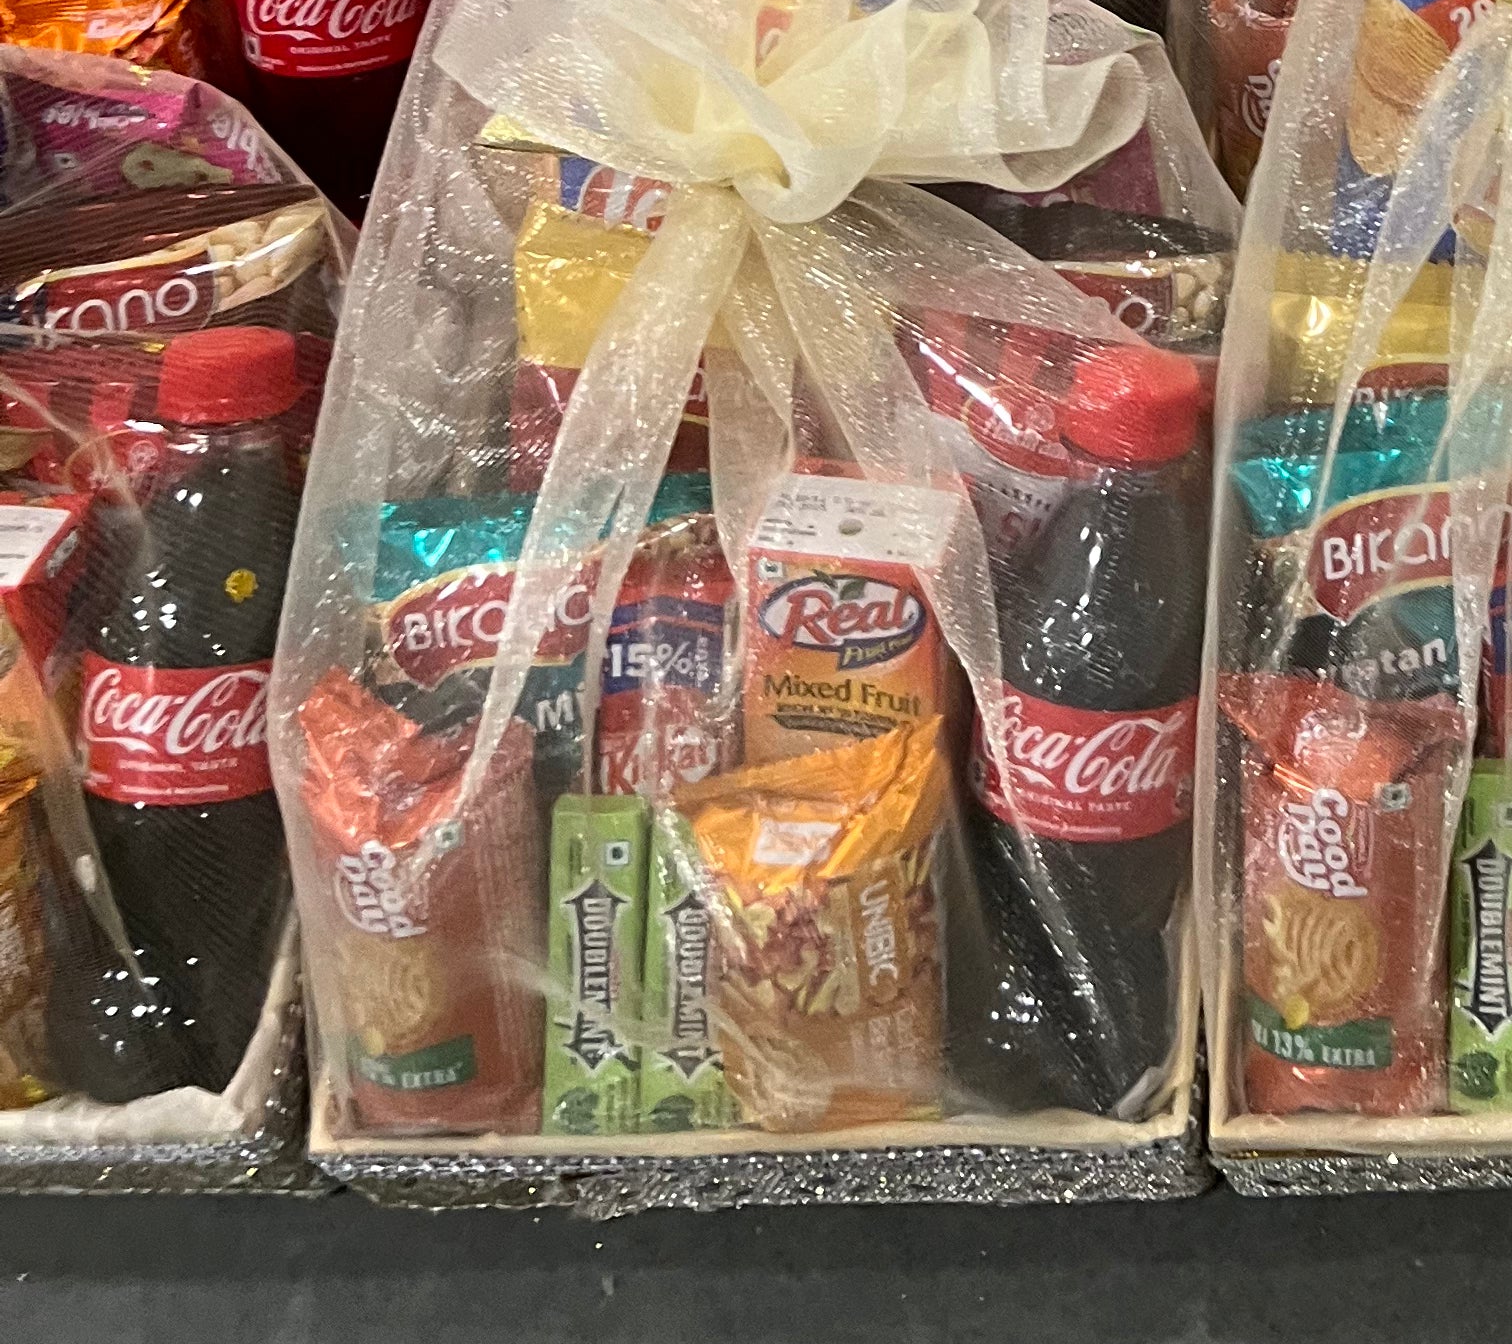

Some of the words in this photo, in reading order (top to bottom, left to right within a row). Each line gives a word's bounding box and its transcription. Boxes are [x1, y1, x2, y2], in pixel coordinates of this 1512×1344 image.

[783, 588, 908, 644] Real
[84, 667, 270, 755] Coca-Cola
[762, 673, 852, 703] Mixed
[859, 680, 923, 715] Fruit
[1000, 694, 1187, 796] Coca-Cola
[1284, 802, 1331, 890] Day
[1311, 788, 1368, 897] Good
[1476, 857, 1507, 1015] DOUBLEMINT
